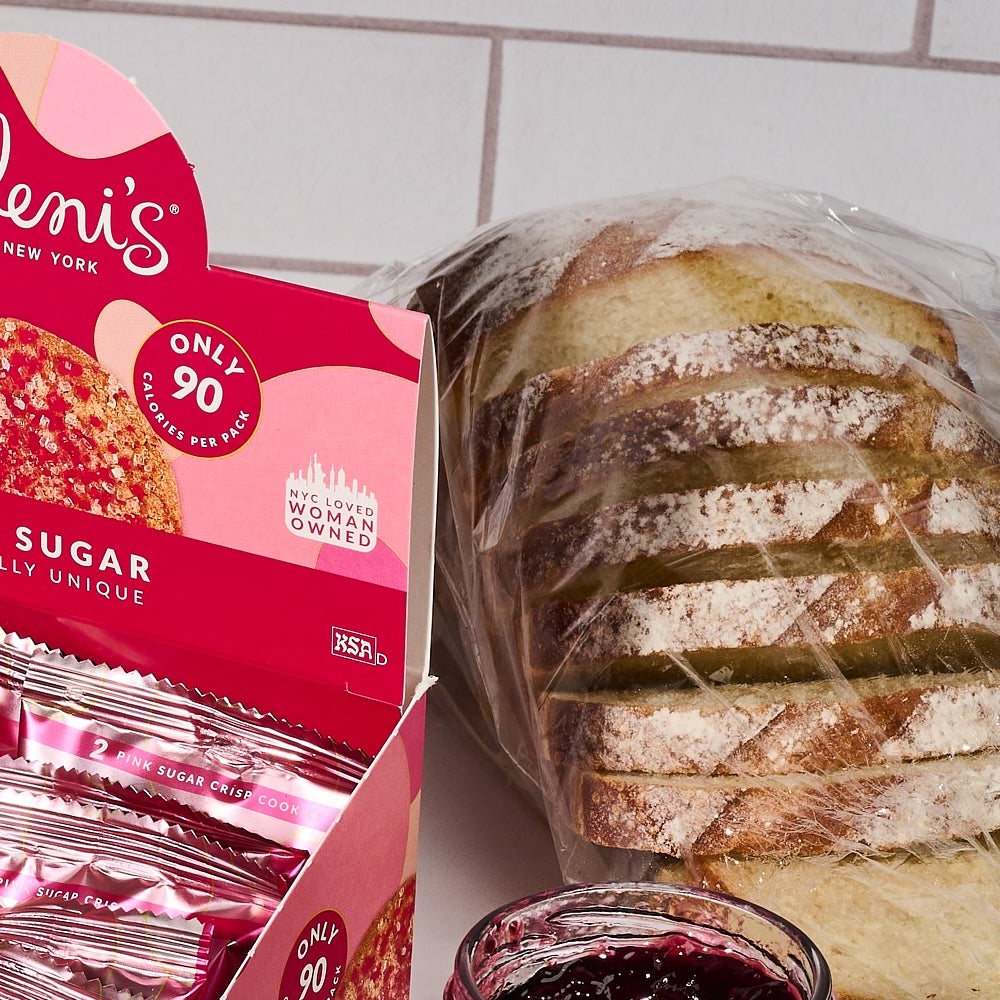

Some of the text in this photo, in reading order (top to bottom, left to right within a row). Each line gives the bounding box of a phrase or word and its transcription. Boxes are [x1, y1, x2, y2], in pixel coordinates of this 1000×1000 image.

[3, 241, 99, 275] NEW YORK
[170, 332, 246, 376] ONLY
[171, 365, 223, 413] 90
[143, 372, 250, 448] CALORIES PER PACK
[289, 500, 374, 533] WOMAN
[290, 489, 374, 517] NYC LOVED
[291, 517, 370, 547] OWNED
[16, 526, 151, 582] SUGAR
[50, 568, 144, 605] UNIQUE
[89, 738, 109, 760] 2
[116, 751, 153, 772] PINK
[157, 765, 205, 787] SUGAR
[210, 781, 253, 800] CRISP
[297, 921, 340, 960] ONLY
